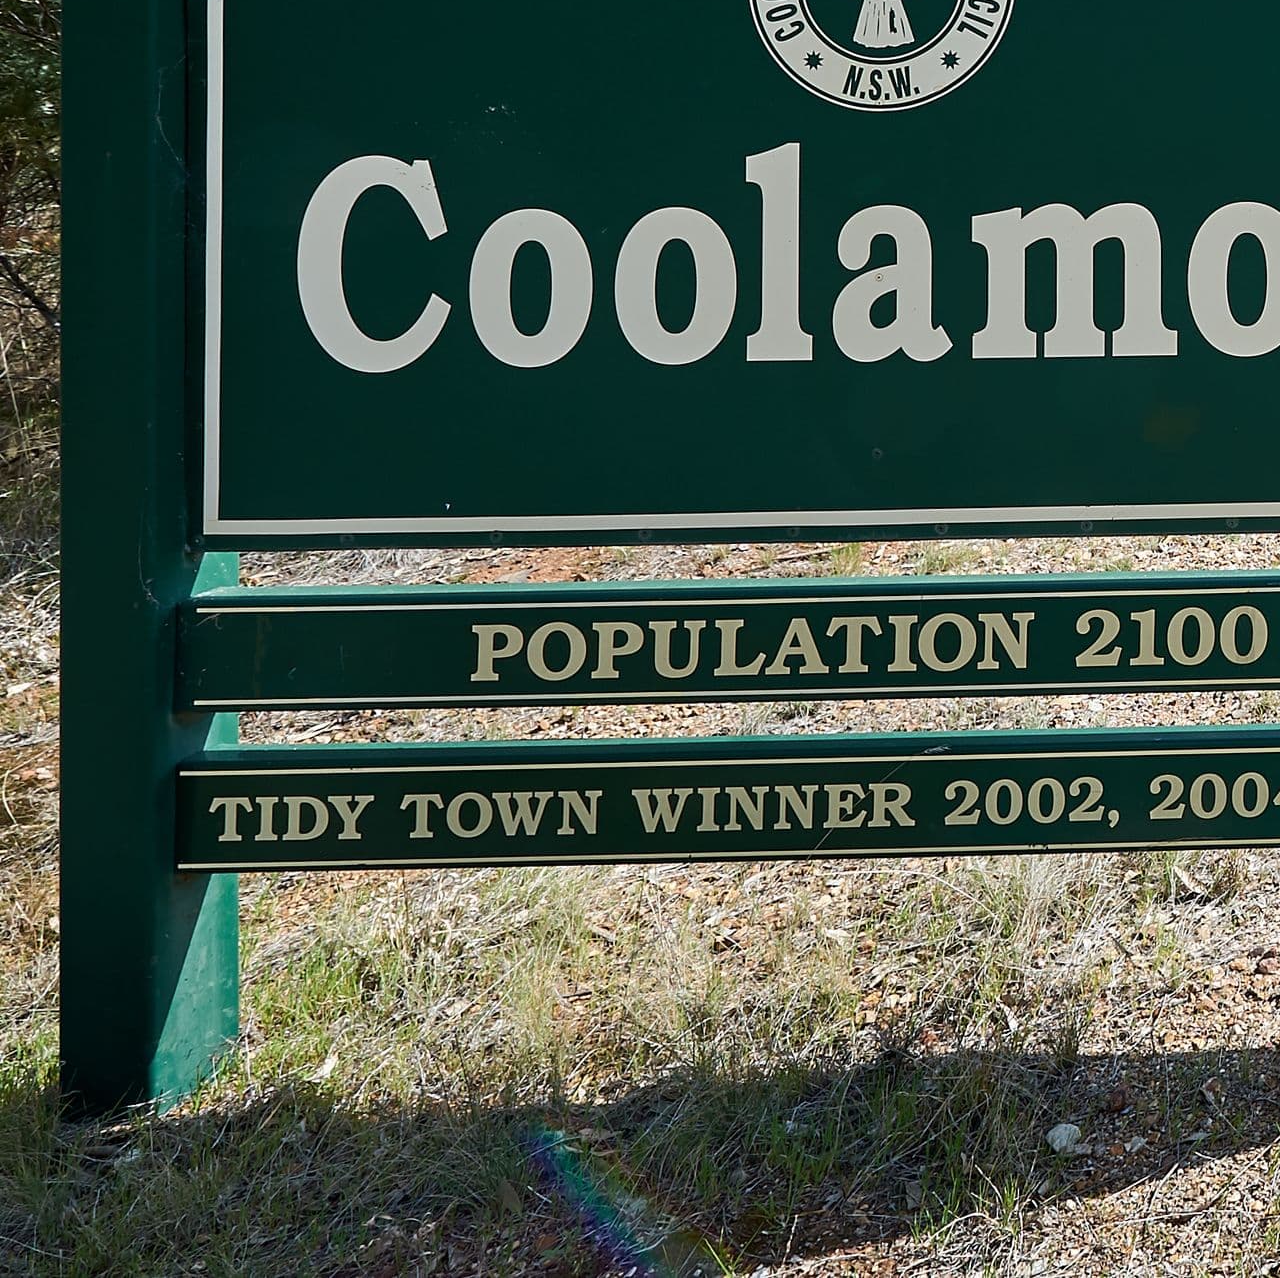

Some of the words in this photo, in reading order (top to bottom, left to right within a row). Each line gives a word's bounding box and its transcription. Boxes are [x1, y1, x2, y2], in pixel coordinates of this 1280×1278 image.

[843, 66, 920, 100] N.S.W.
[471, 612, 1035, 682] POPULATION
[1075, 605, 1269, 668] 2100
[209, 794, 375, 842] TIDY
[399, 790, 603, 839] TOWN
[632, 782, 916, 833] WINNER
[944, 776, 1120, 828] 2002,
